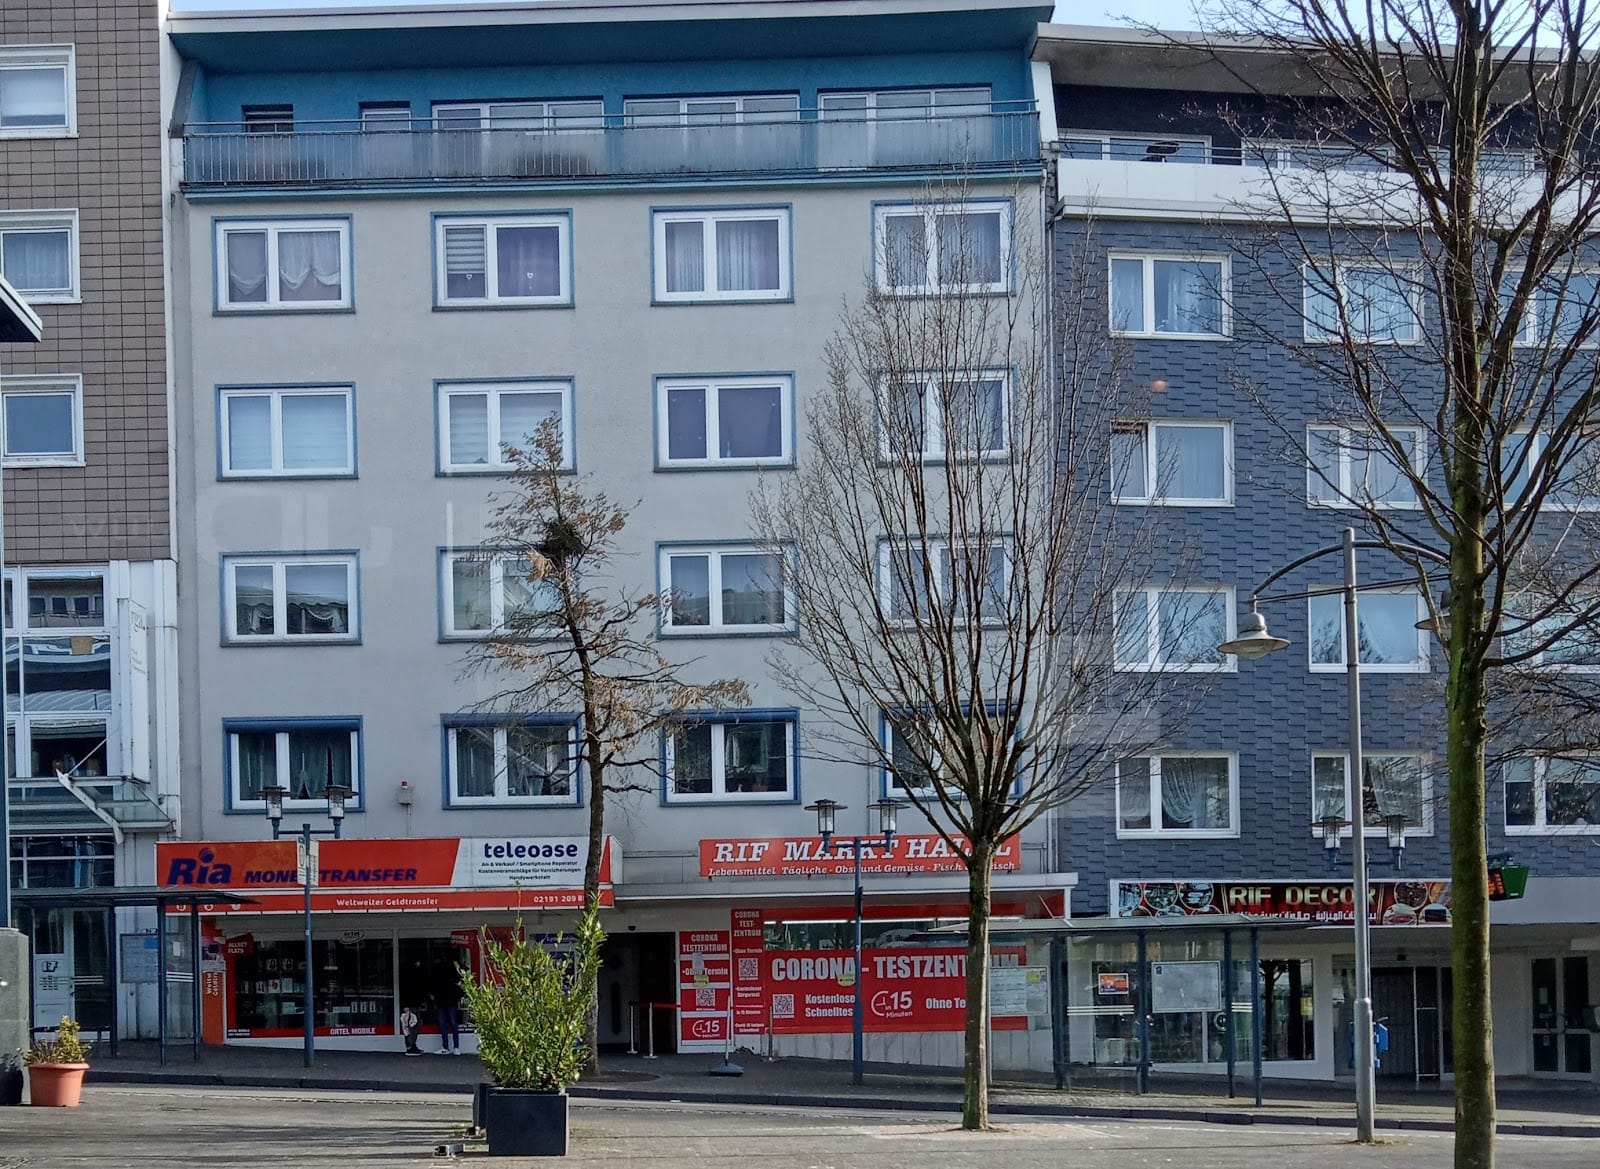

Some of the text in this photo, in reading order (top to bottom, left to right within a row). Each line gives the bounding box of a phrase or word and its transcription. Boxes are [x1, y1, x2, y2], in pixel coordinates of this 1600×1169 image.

[484, 841, 578, 859] teleoase
[713, 837, 1012, 862] RIF MARKT HALL
[167, 847, 233, 885] Ria
[708, 866, 776, 877] Lebensmittel
[781, 865, 827, 876] Tägliche
[861, 864, 882, 873] und
[884, 863, 925, 873] Gemüse
[933, 862, 963, 872] Fisch
[245, 870, 298, 884] MONE
[319, 868, 418, 882] TRANSFER
[336, 897, 439, 907] Weltweiter Geldtransfer
[1229, 886, 1272, 906] RIF
[682, 943, 728, 952] TESTZENTRUM
[772, 957, 856, 981] CORONA
[873, 954, 1019, 979] TESTZENTM
[805, 994, 856, 1005] Kostenlose
[890, 990, 913, 1010] 15
[925, 998, 953, 1009] Ohne
[805, 1007, 854, 1018] Schnelltes
[886, 1010, 913, 1018] Minuten
[330, 1027, 376, 1035] ORTEL MOBILE
[705, 1020, 720, 1033] 15
